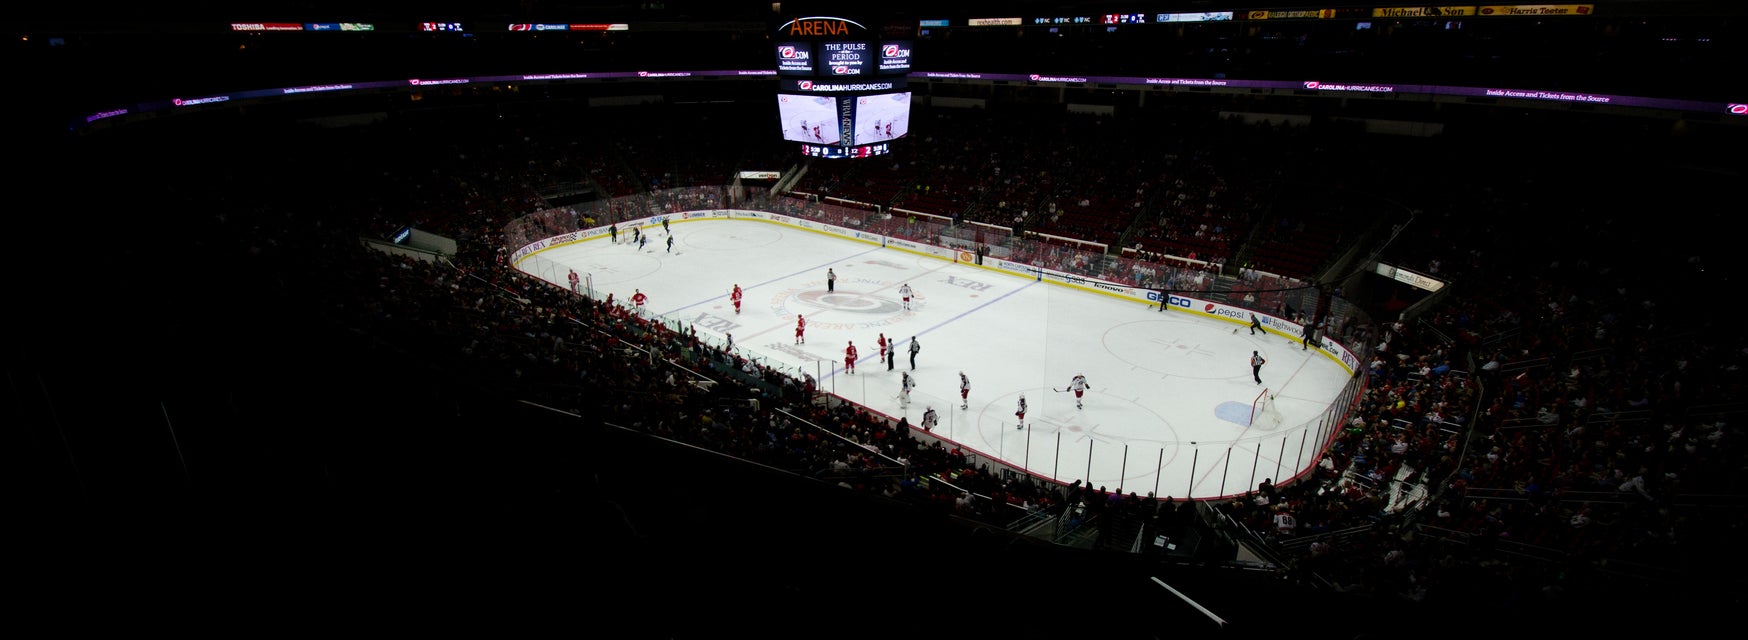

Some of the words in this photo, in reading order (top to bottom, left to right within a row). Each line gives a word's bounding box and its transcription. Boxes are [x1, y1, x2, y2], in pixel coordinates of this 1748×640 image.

[1382, 7, 1422, 16] Michael
[1443, 7, 1464, 16] Son
[231, 23, 265, 31] TOSHIBA
[790, 18, 849, 35] ARENA
[812, 83, 893, 91] CAROLINAHURRICANES.COM
[1318, 84, 1393, 92] CAROLINAHURRICANES.COM
[1587, 95, 1610, 103] Source
[843, 119, 852, 146] NEWS
[822, 147, 829, 155] 0
[945, 276, 992, 291] REX
[1217, 307, 1245, 319] pepsi
